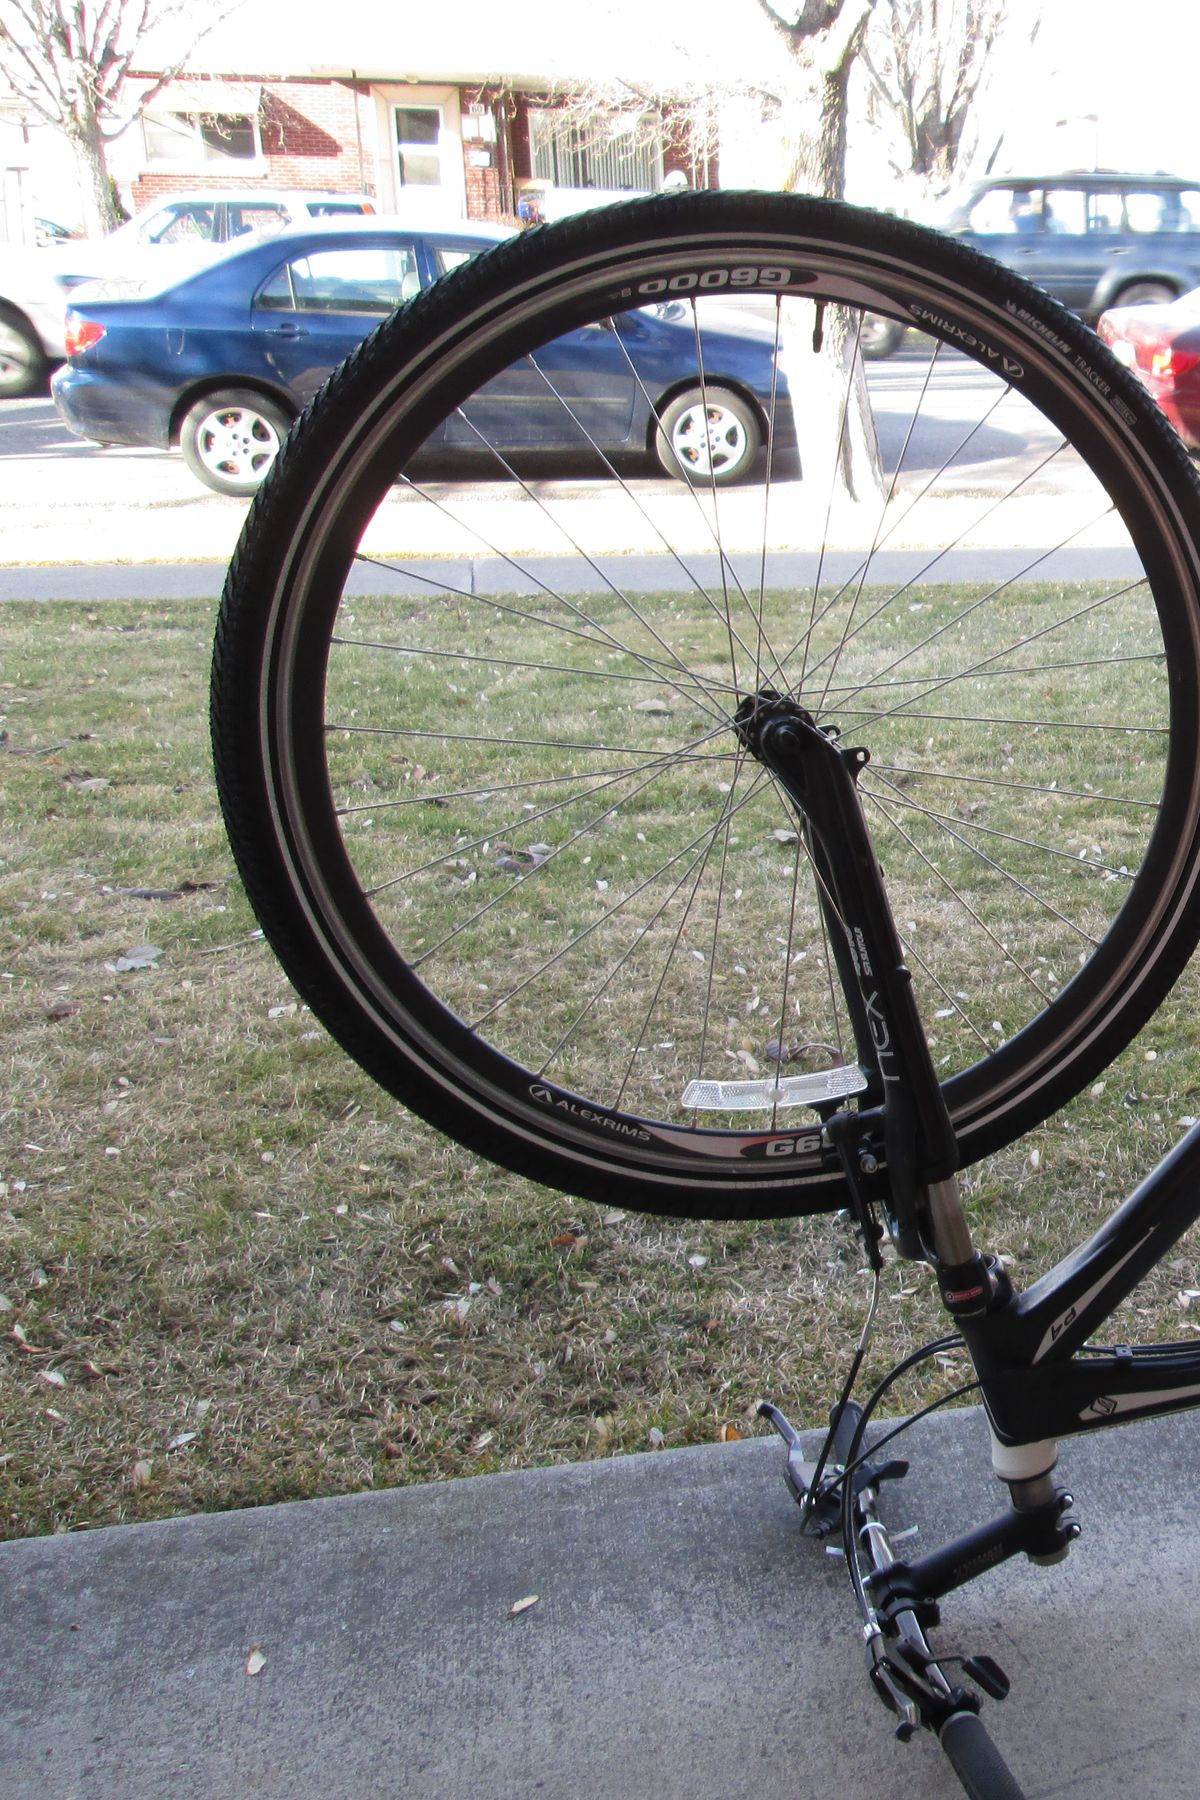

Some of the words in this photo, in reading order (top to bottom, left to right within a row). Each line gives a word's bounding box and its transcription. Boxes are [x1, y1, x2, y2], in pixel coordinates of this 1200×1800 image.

[638, 267, 791, 294] G6000
[909, 303, 1000, 359] ALEXRIMS
[1016, 307, 1072, 354] MICHELIN
[1074, 355, 1112, 396] TRACKER
[556, 1100, 652, 1142] ALEXRIMS
